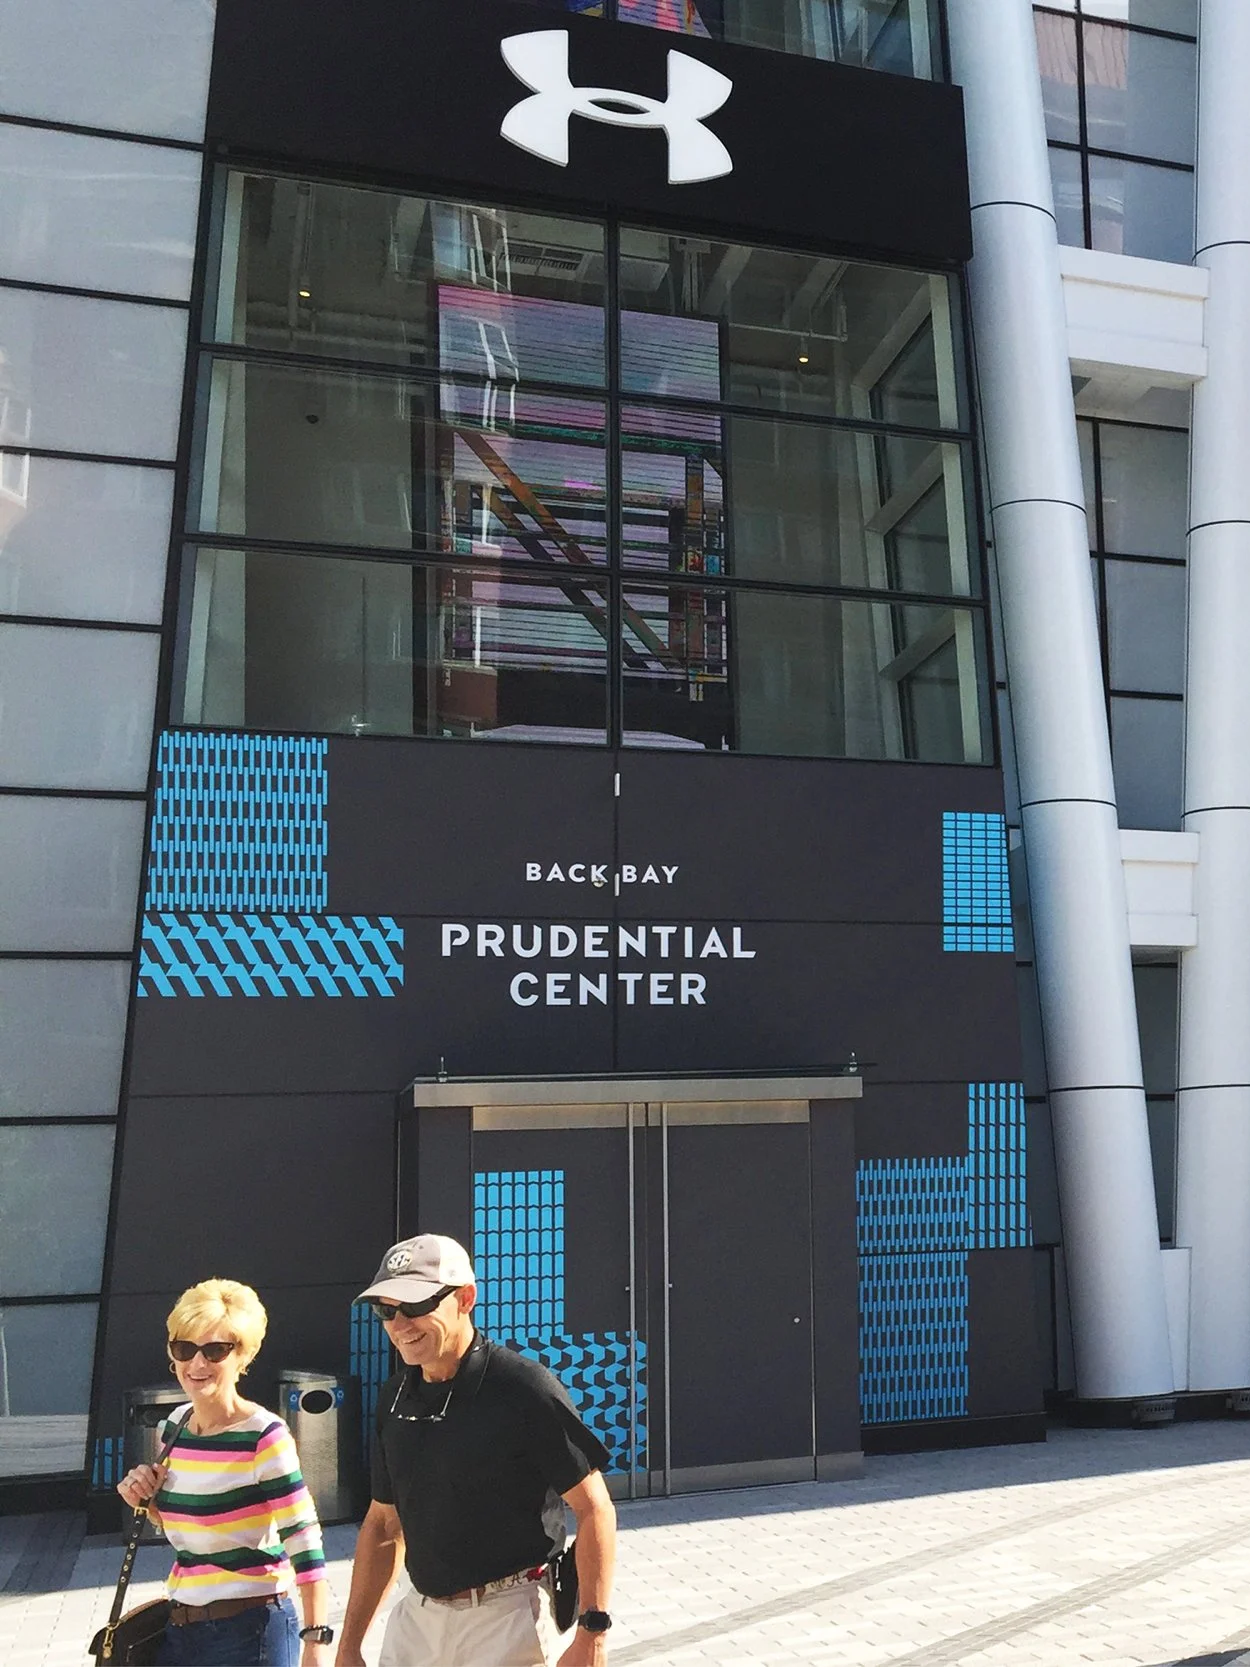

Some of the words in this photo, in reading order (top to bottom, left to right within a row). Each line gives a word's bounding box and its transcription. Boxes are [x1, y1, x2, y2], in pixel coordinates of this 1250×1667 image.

[525, 862, 608, 884] BACK
[621, 864, 679, 884] BAY
[441, 923, 757, 958] PRUDENTIAL
[509, 971, 707, 1007] CENTER
